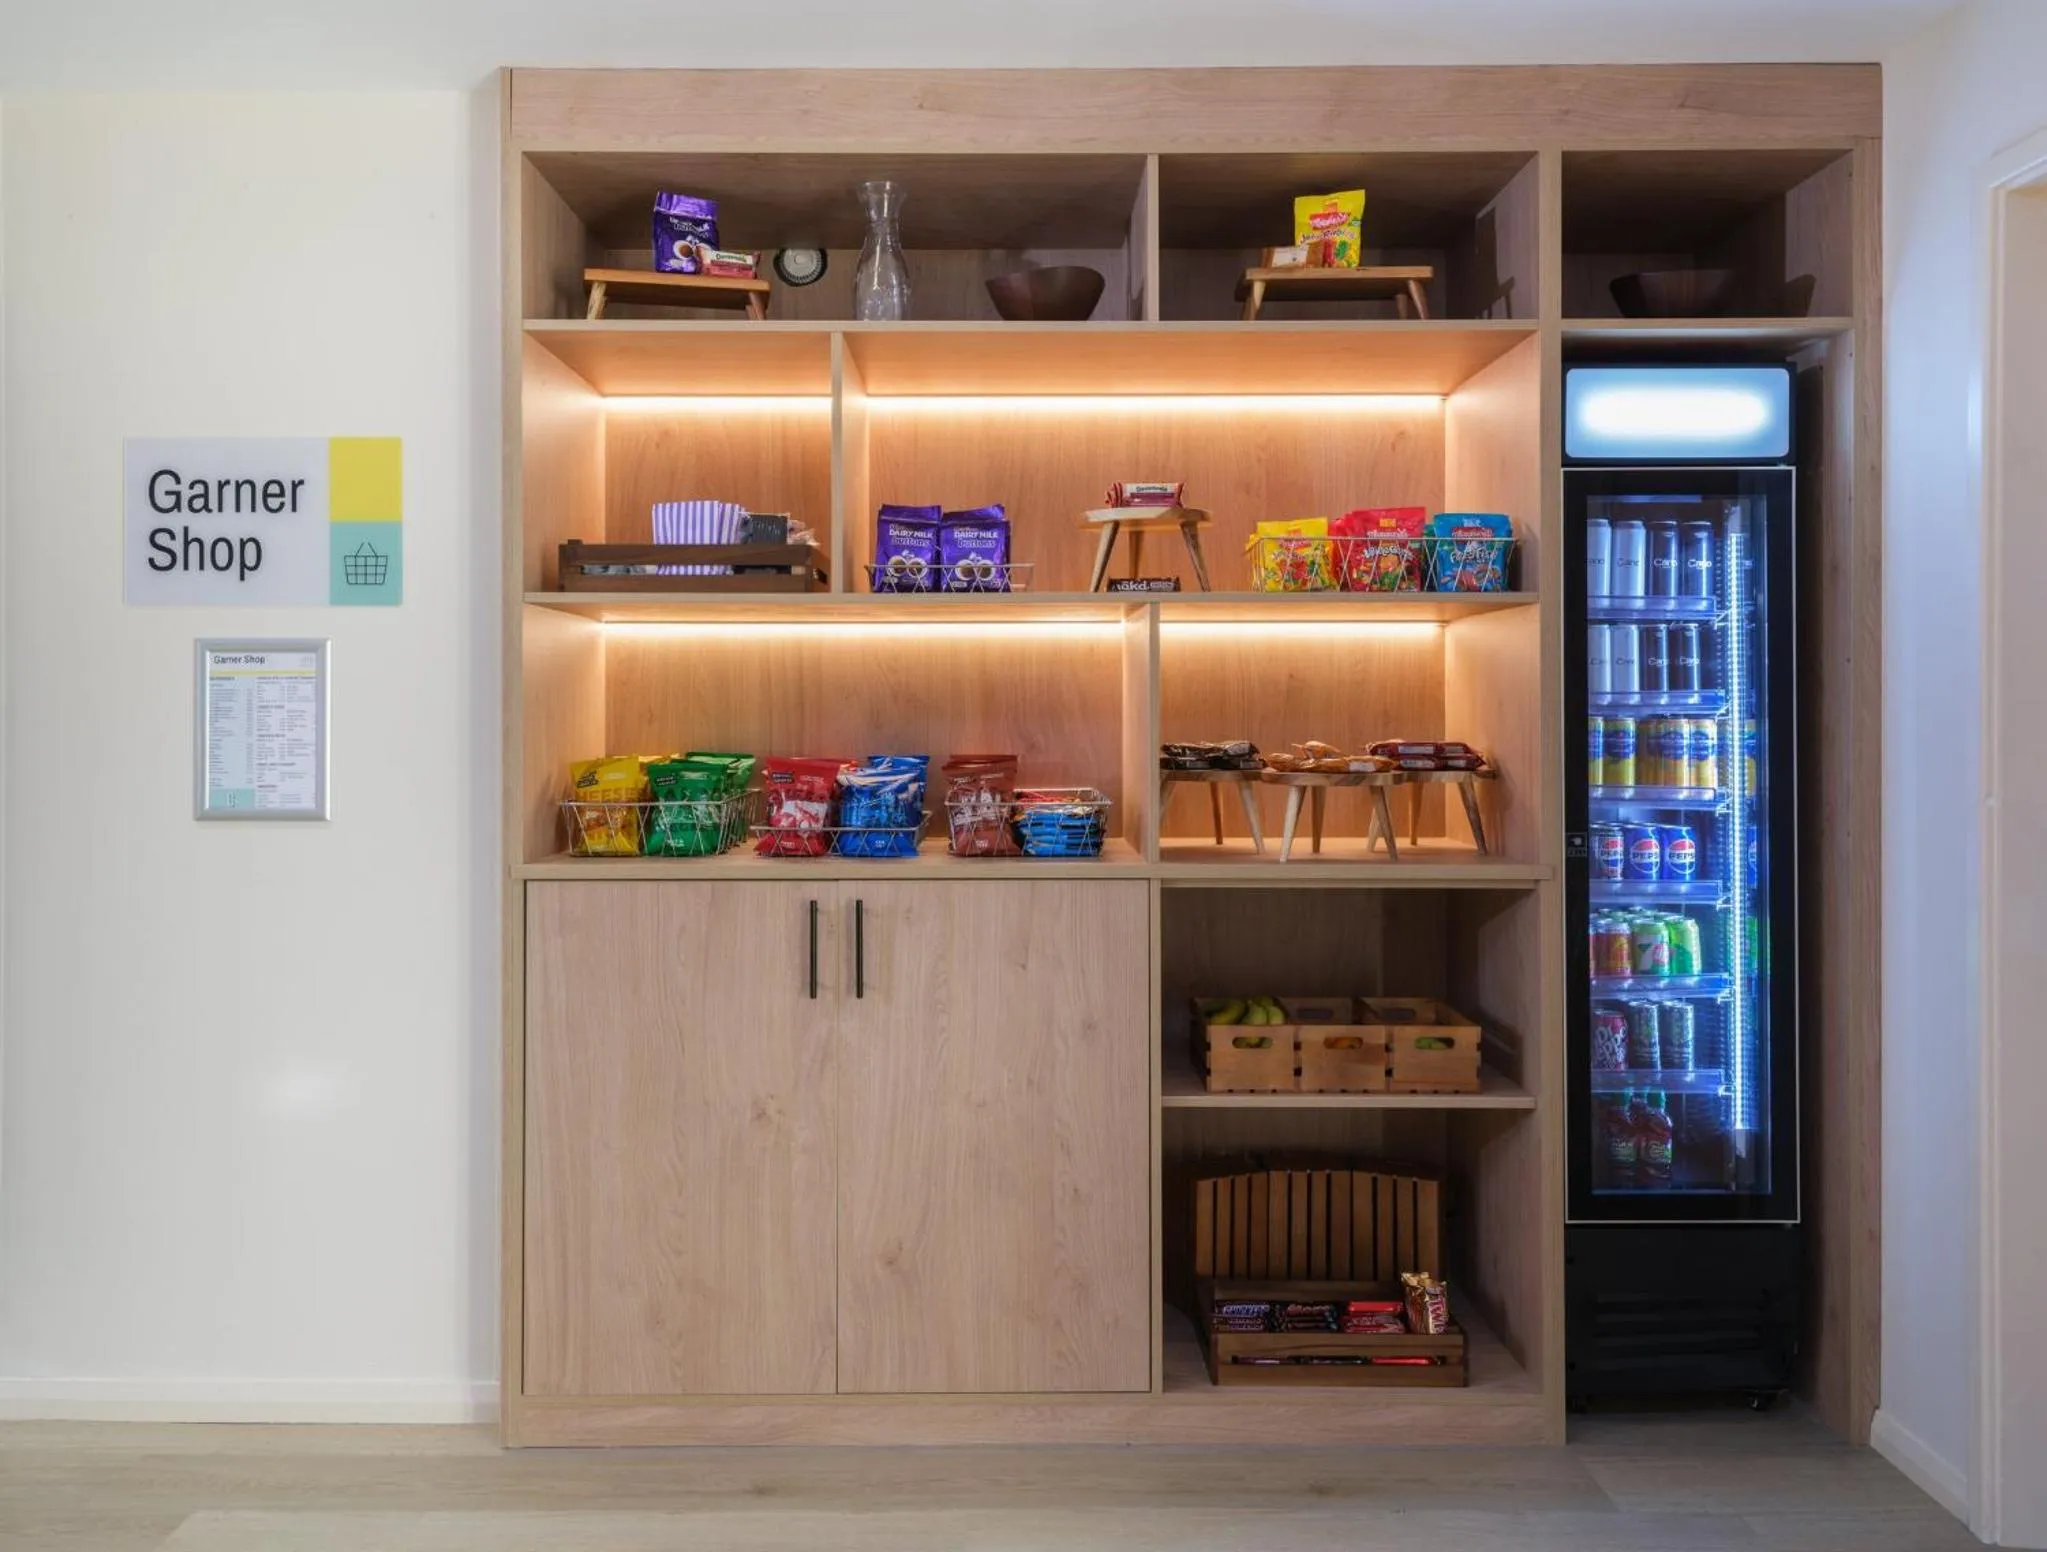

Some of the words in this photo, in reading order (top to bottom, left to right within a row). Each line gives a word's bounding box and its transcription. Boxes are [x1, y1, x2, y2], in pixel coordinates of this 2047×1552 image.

[148, 468, 305, 514] Garner
[148, 525, 263, 582] Shop
[213, 655, 242, 665] Garner
[243, 655, 266, 667] Shop
